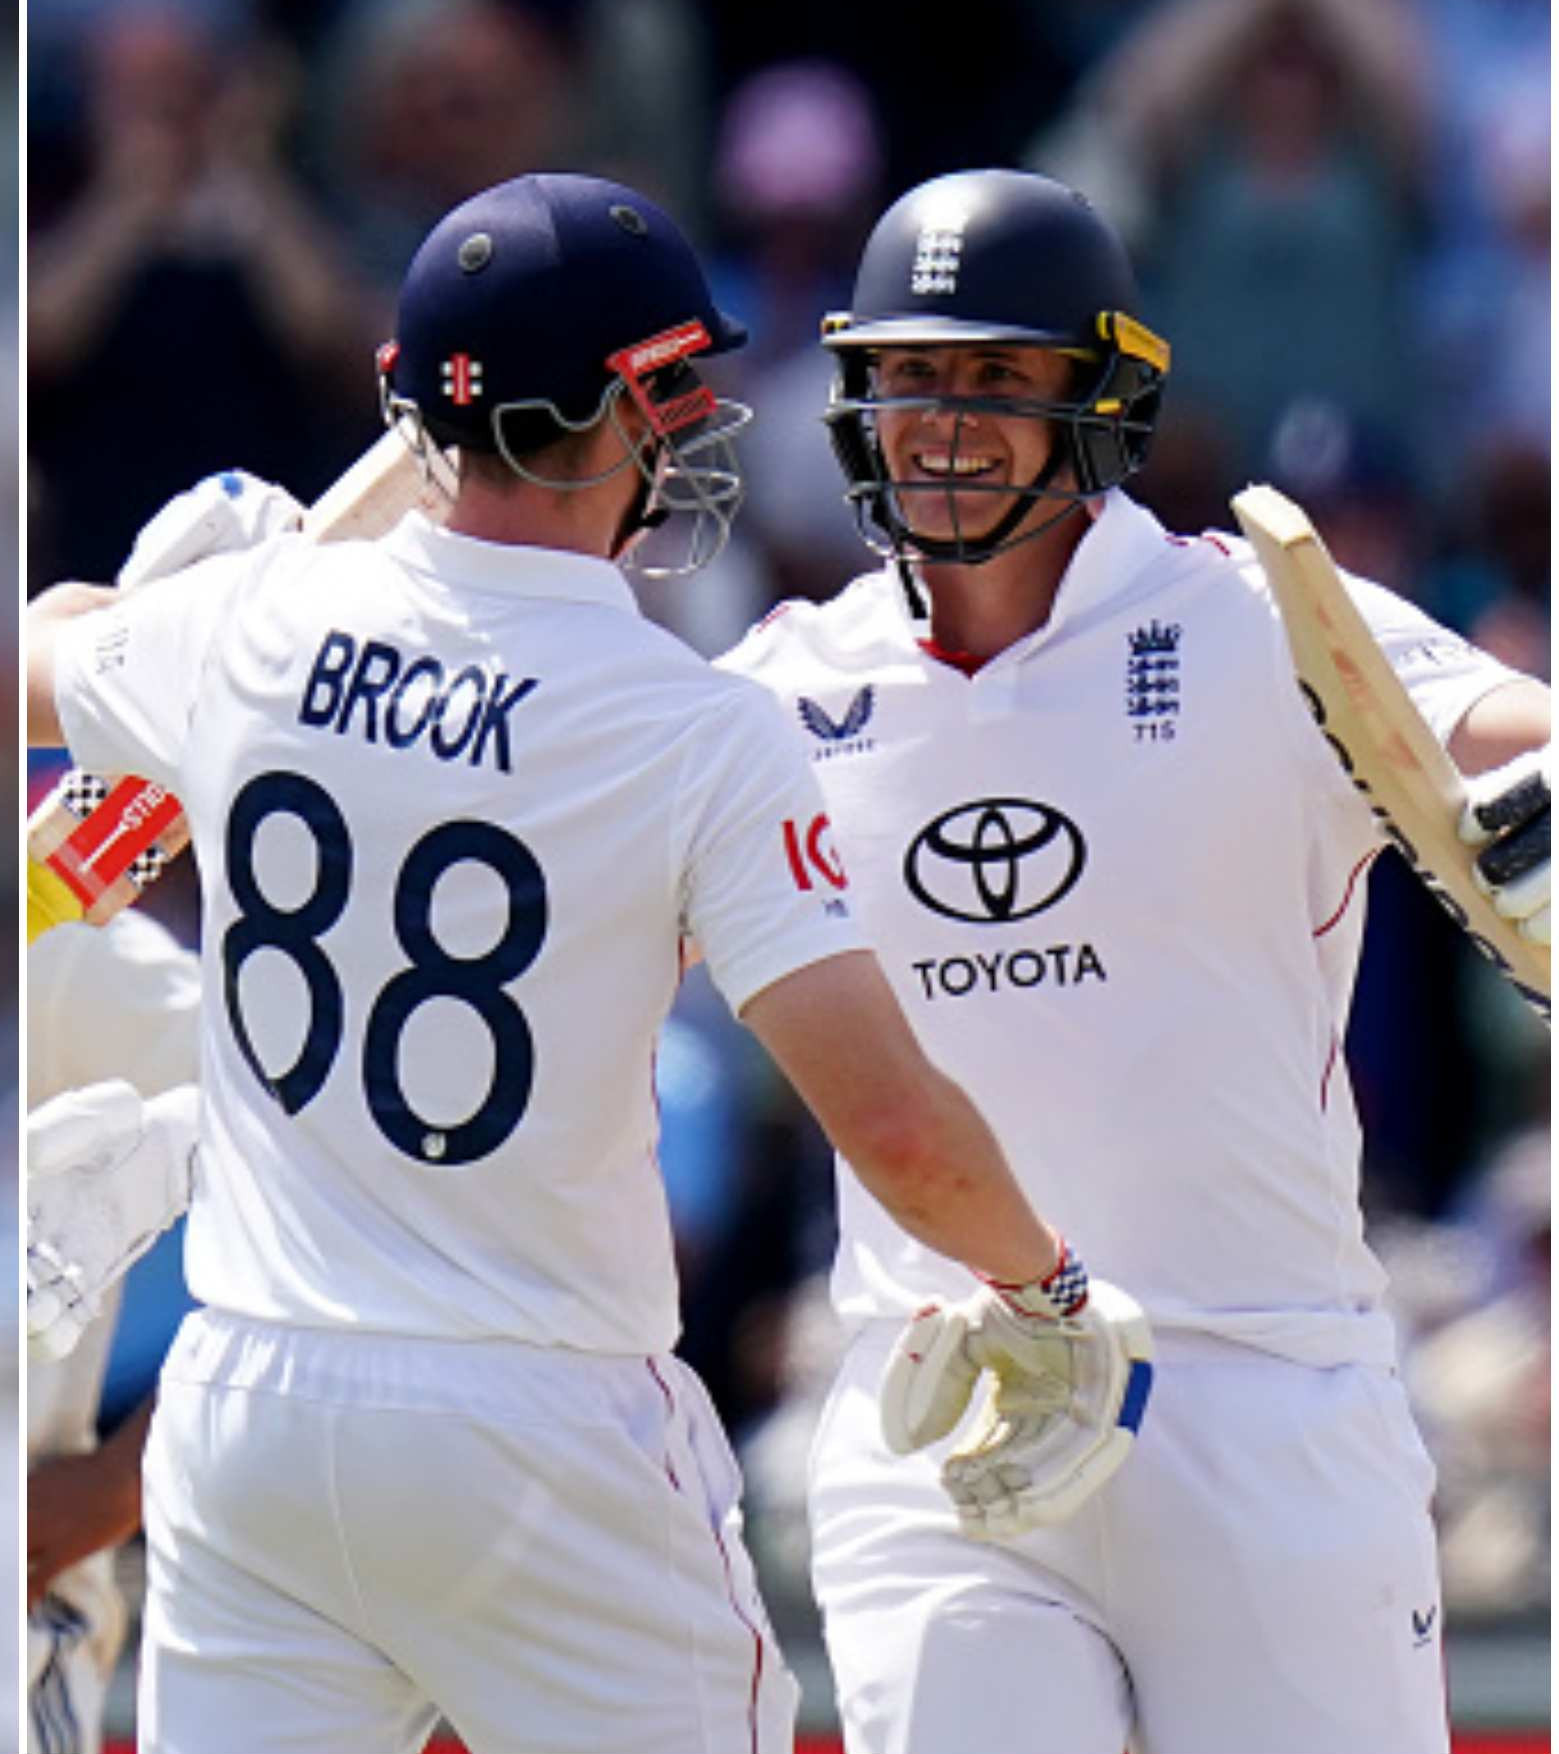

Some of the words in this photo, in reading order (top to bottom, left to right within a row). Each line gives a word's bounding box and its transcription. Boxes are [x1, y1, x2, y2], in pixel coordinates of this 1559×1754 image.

[298, 630, 538, 774] BROOK
[223, 770, 548, 1166] 88
[913, 944, 1107, 999] TOYOTA
